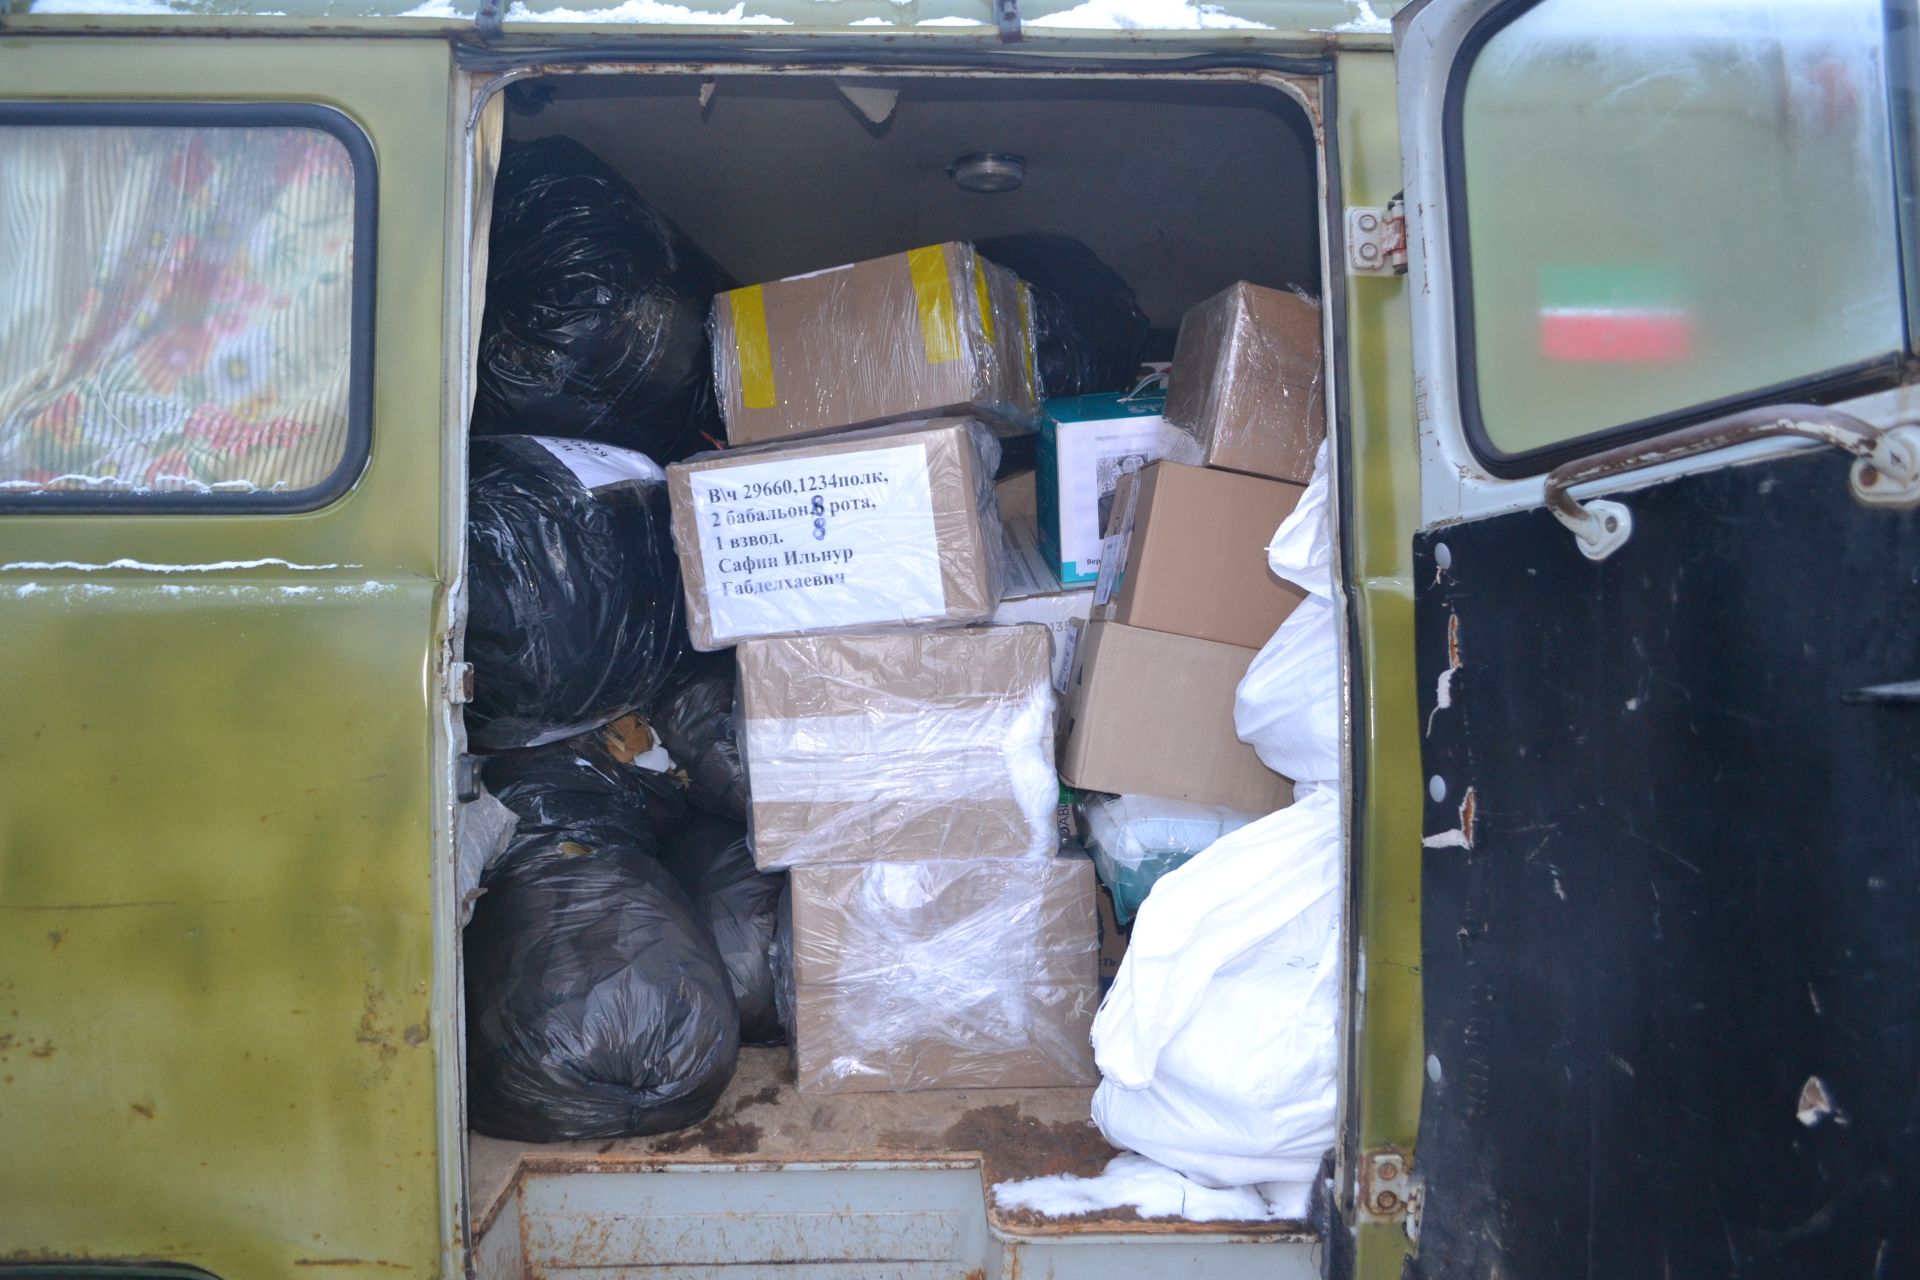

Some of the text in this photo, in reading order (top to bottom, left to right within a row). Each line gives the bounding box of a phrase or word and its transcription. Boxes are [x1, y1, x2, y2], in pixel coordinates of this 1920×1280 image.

[743, 471, 889, 500] 29660,1234полк,
[711, 512, 721, 527] 2
[829, 497, 876, 517] рота,
[716, 532, 784, 550] 1 взвод.
[718, 547, 854, 574] Сафин Ильнур
